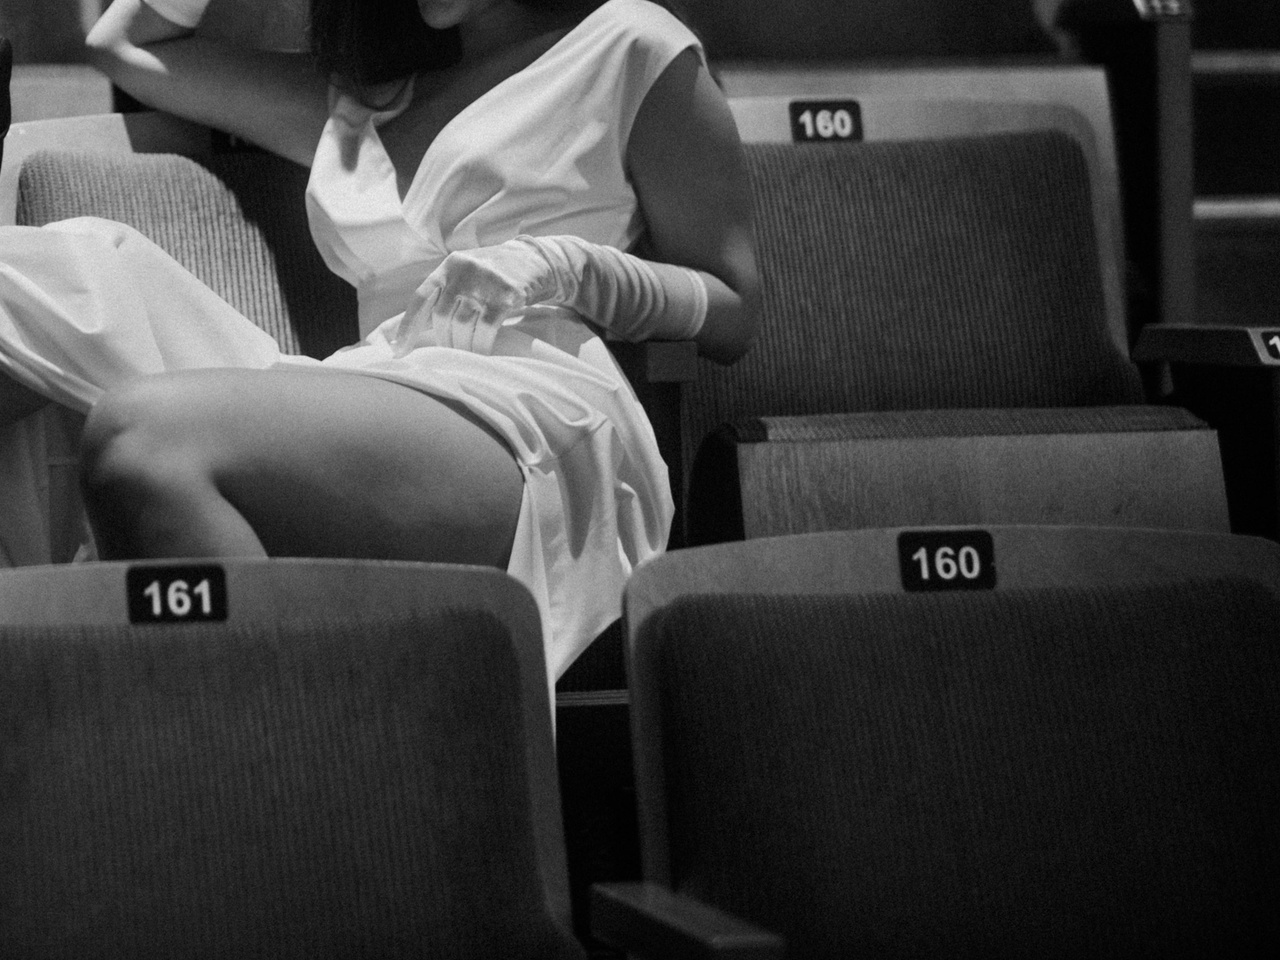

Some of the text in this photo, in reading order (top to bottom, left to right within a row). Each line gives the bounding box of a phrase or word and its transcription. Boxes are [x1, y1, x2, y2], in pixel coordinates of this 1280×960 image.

[798, 109, 852, 138] 160
[912, 546, 980, 580] 160
[144, 579, 211, 616] 161
